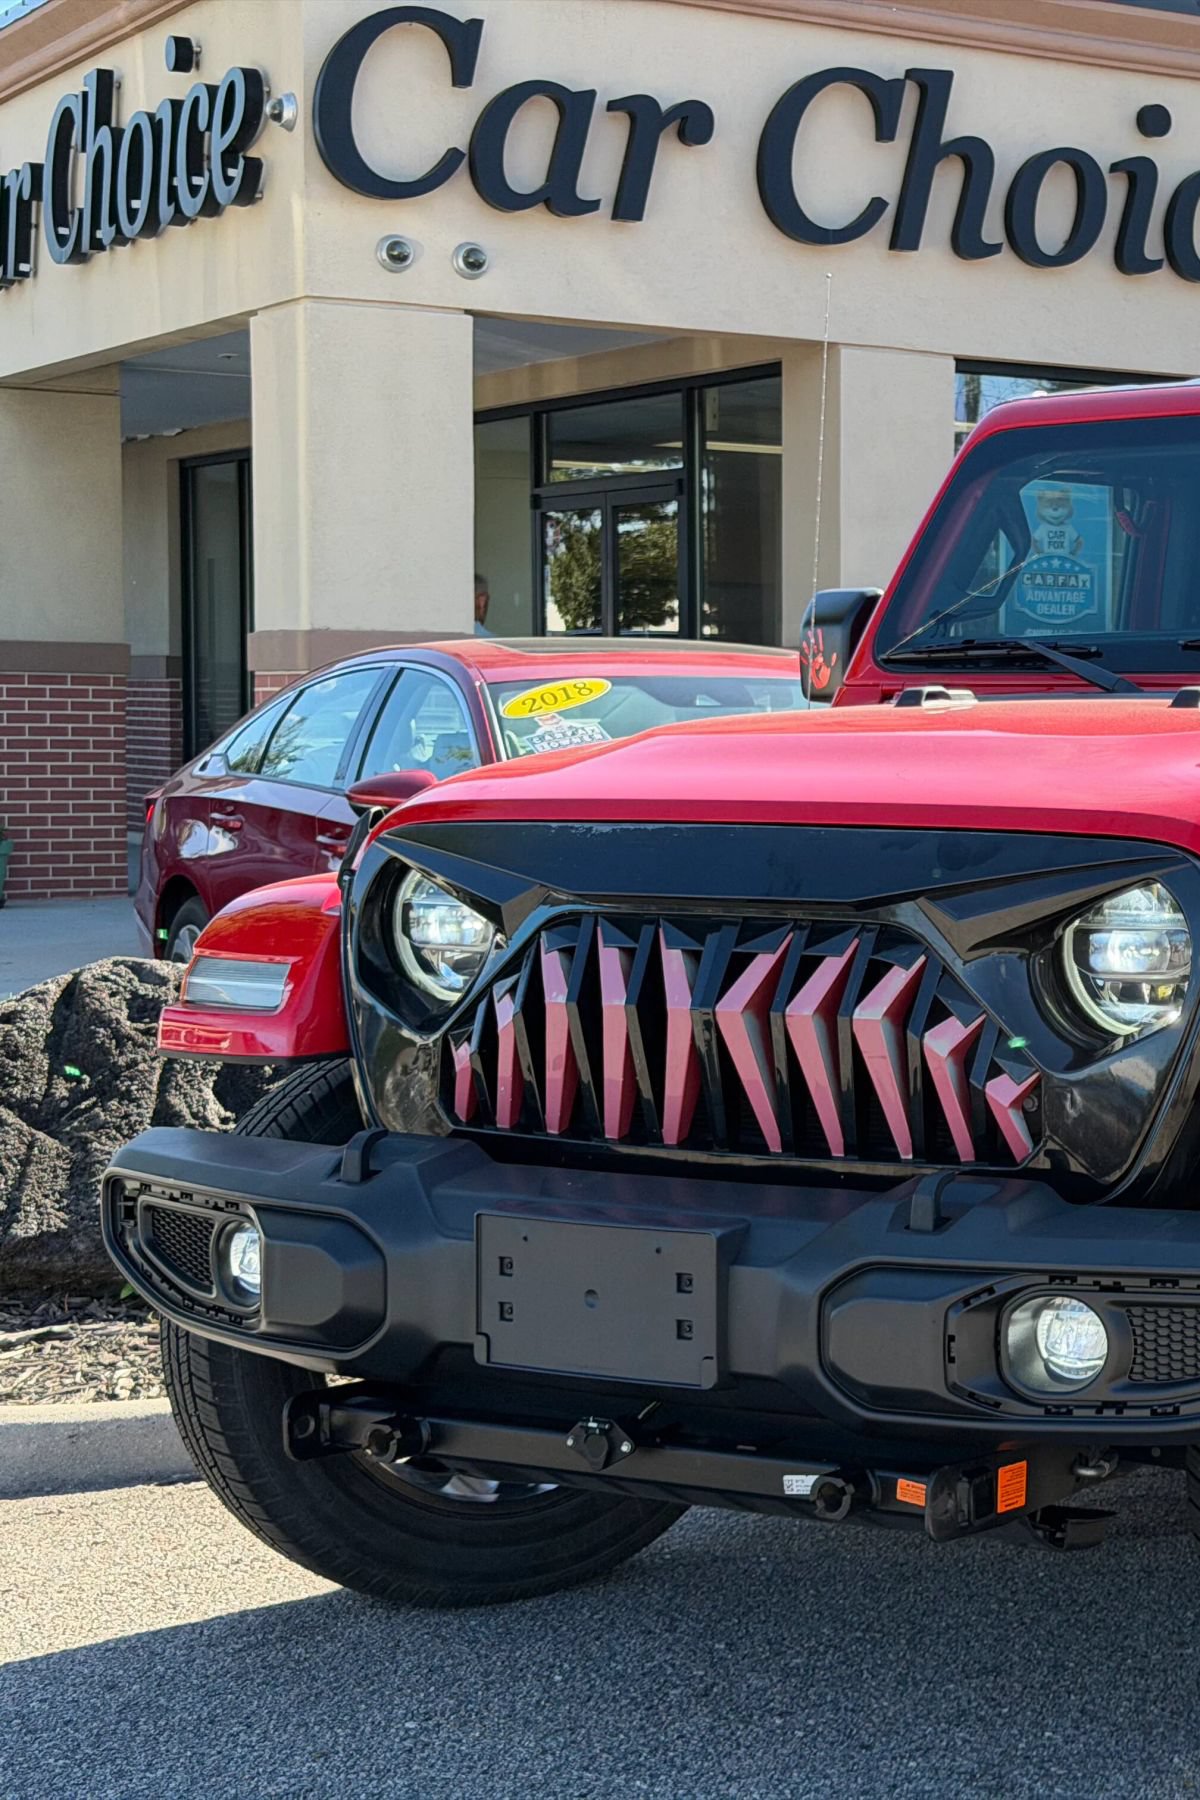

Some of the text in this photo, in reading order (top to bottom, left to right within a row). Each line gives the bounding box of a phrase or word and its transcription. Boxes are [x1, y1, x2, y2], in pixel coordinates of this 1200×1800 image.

[314, 5, 715, 223] Car
[0, 35, 264, 292] r Choice
[1047, 530, 1066, 540] CAR
[1047, 540, 1066, 550] FOX
[1022, 573, 1090, 588] CARFAX
[1025, 590, 1086, 603] ADVANTAGE
[1036, 603, 1076, 615] DEALER
[521, 681, 594, 713] 2018
